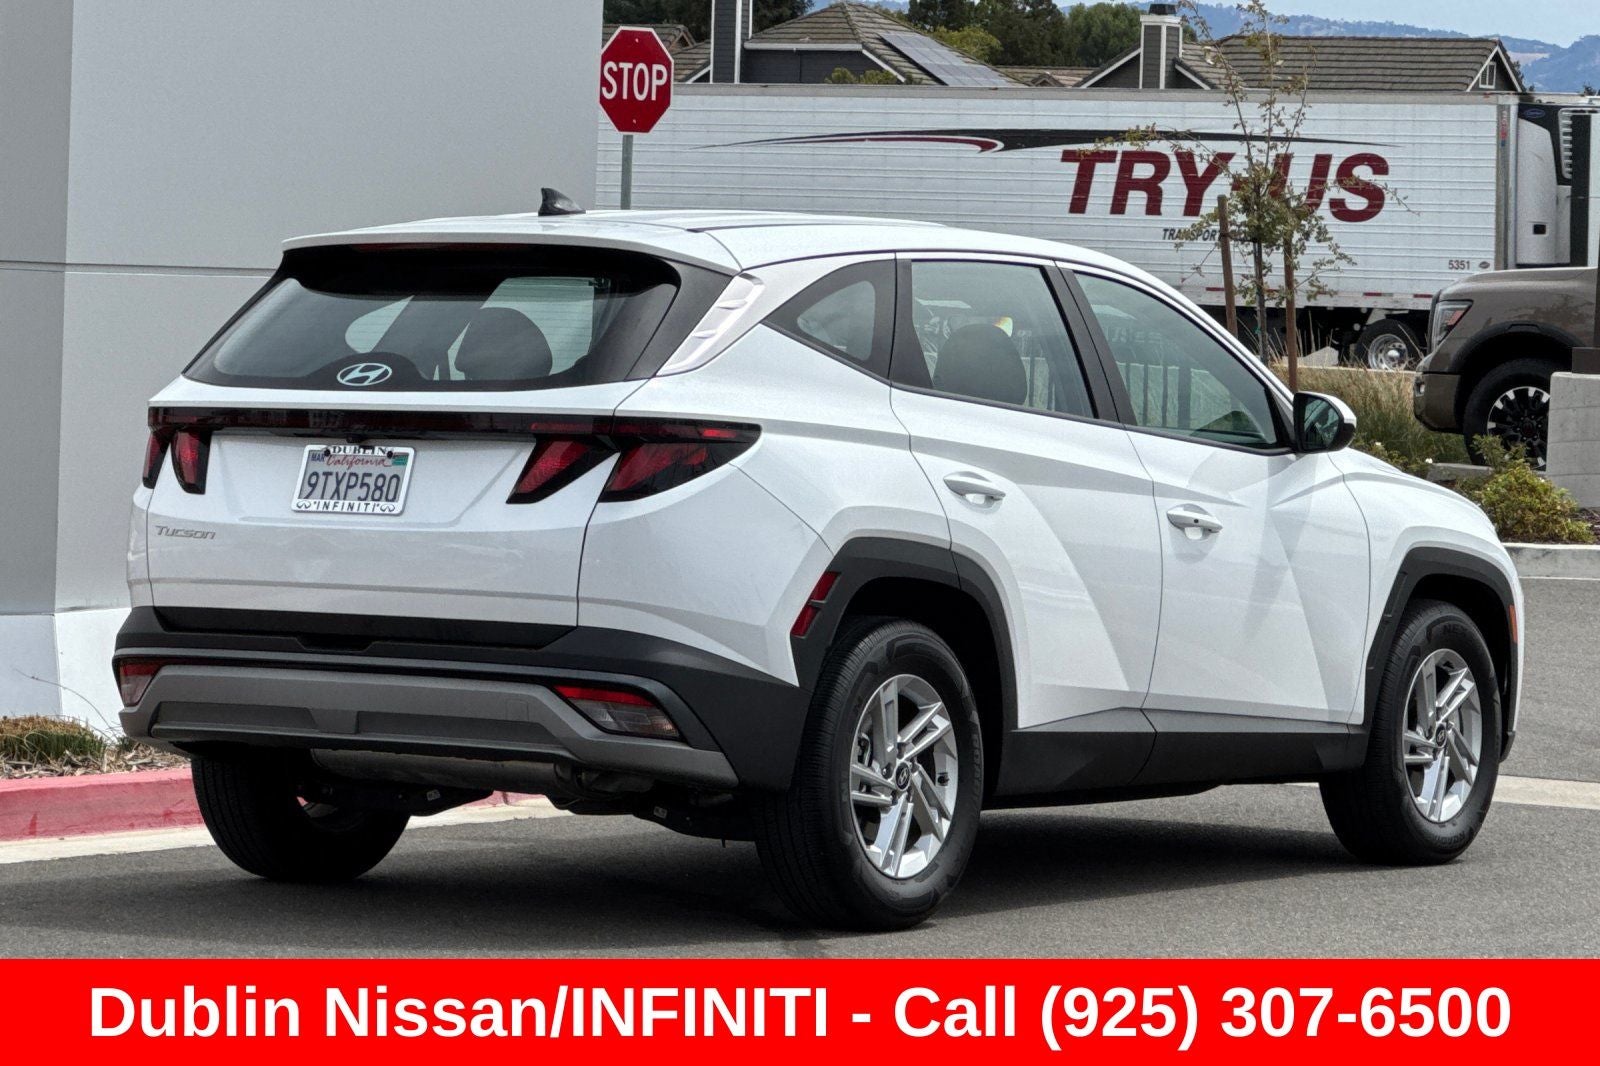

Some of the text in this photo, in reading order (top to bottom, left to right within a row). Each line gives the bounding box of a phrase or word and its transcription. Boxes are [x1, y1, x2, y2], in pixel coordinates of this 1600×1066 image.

[601, 61, 668, 101] STOP
[1448, 259, 1470, 270] 5351
[332, 445, 387, 455] DUBLIN
[325, 454, 392, 470] California
[303, 471, 401, 502] 9TXP580
[316, 501, 377, 512] INFINITI
